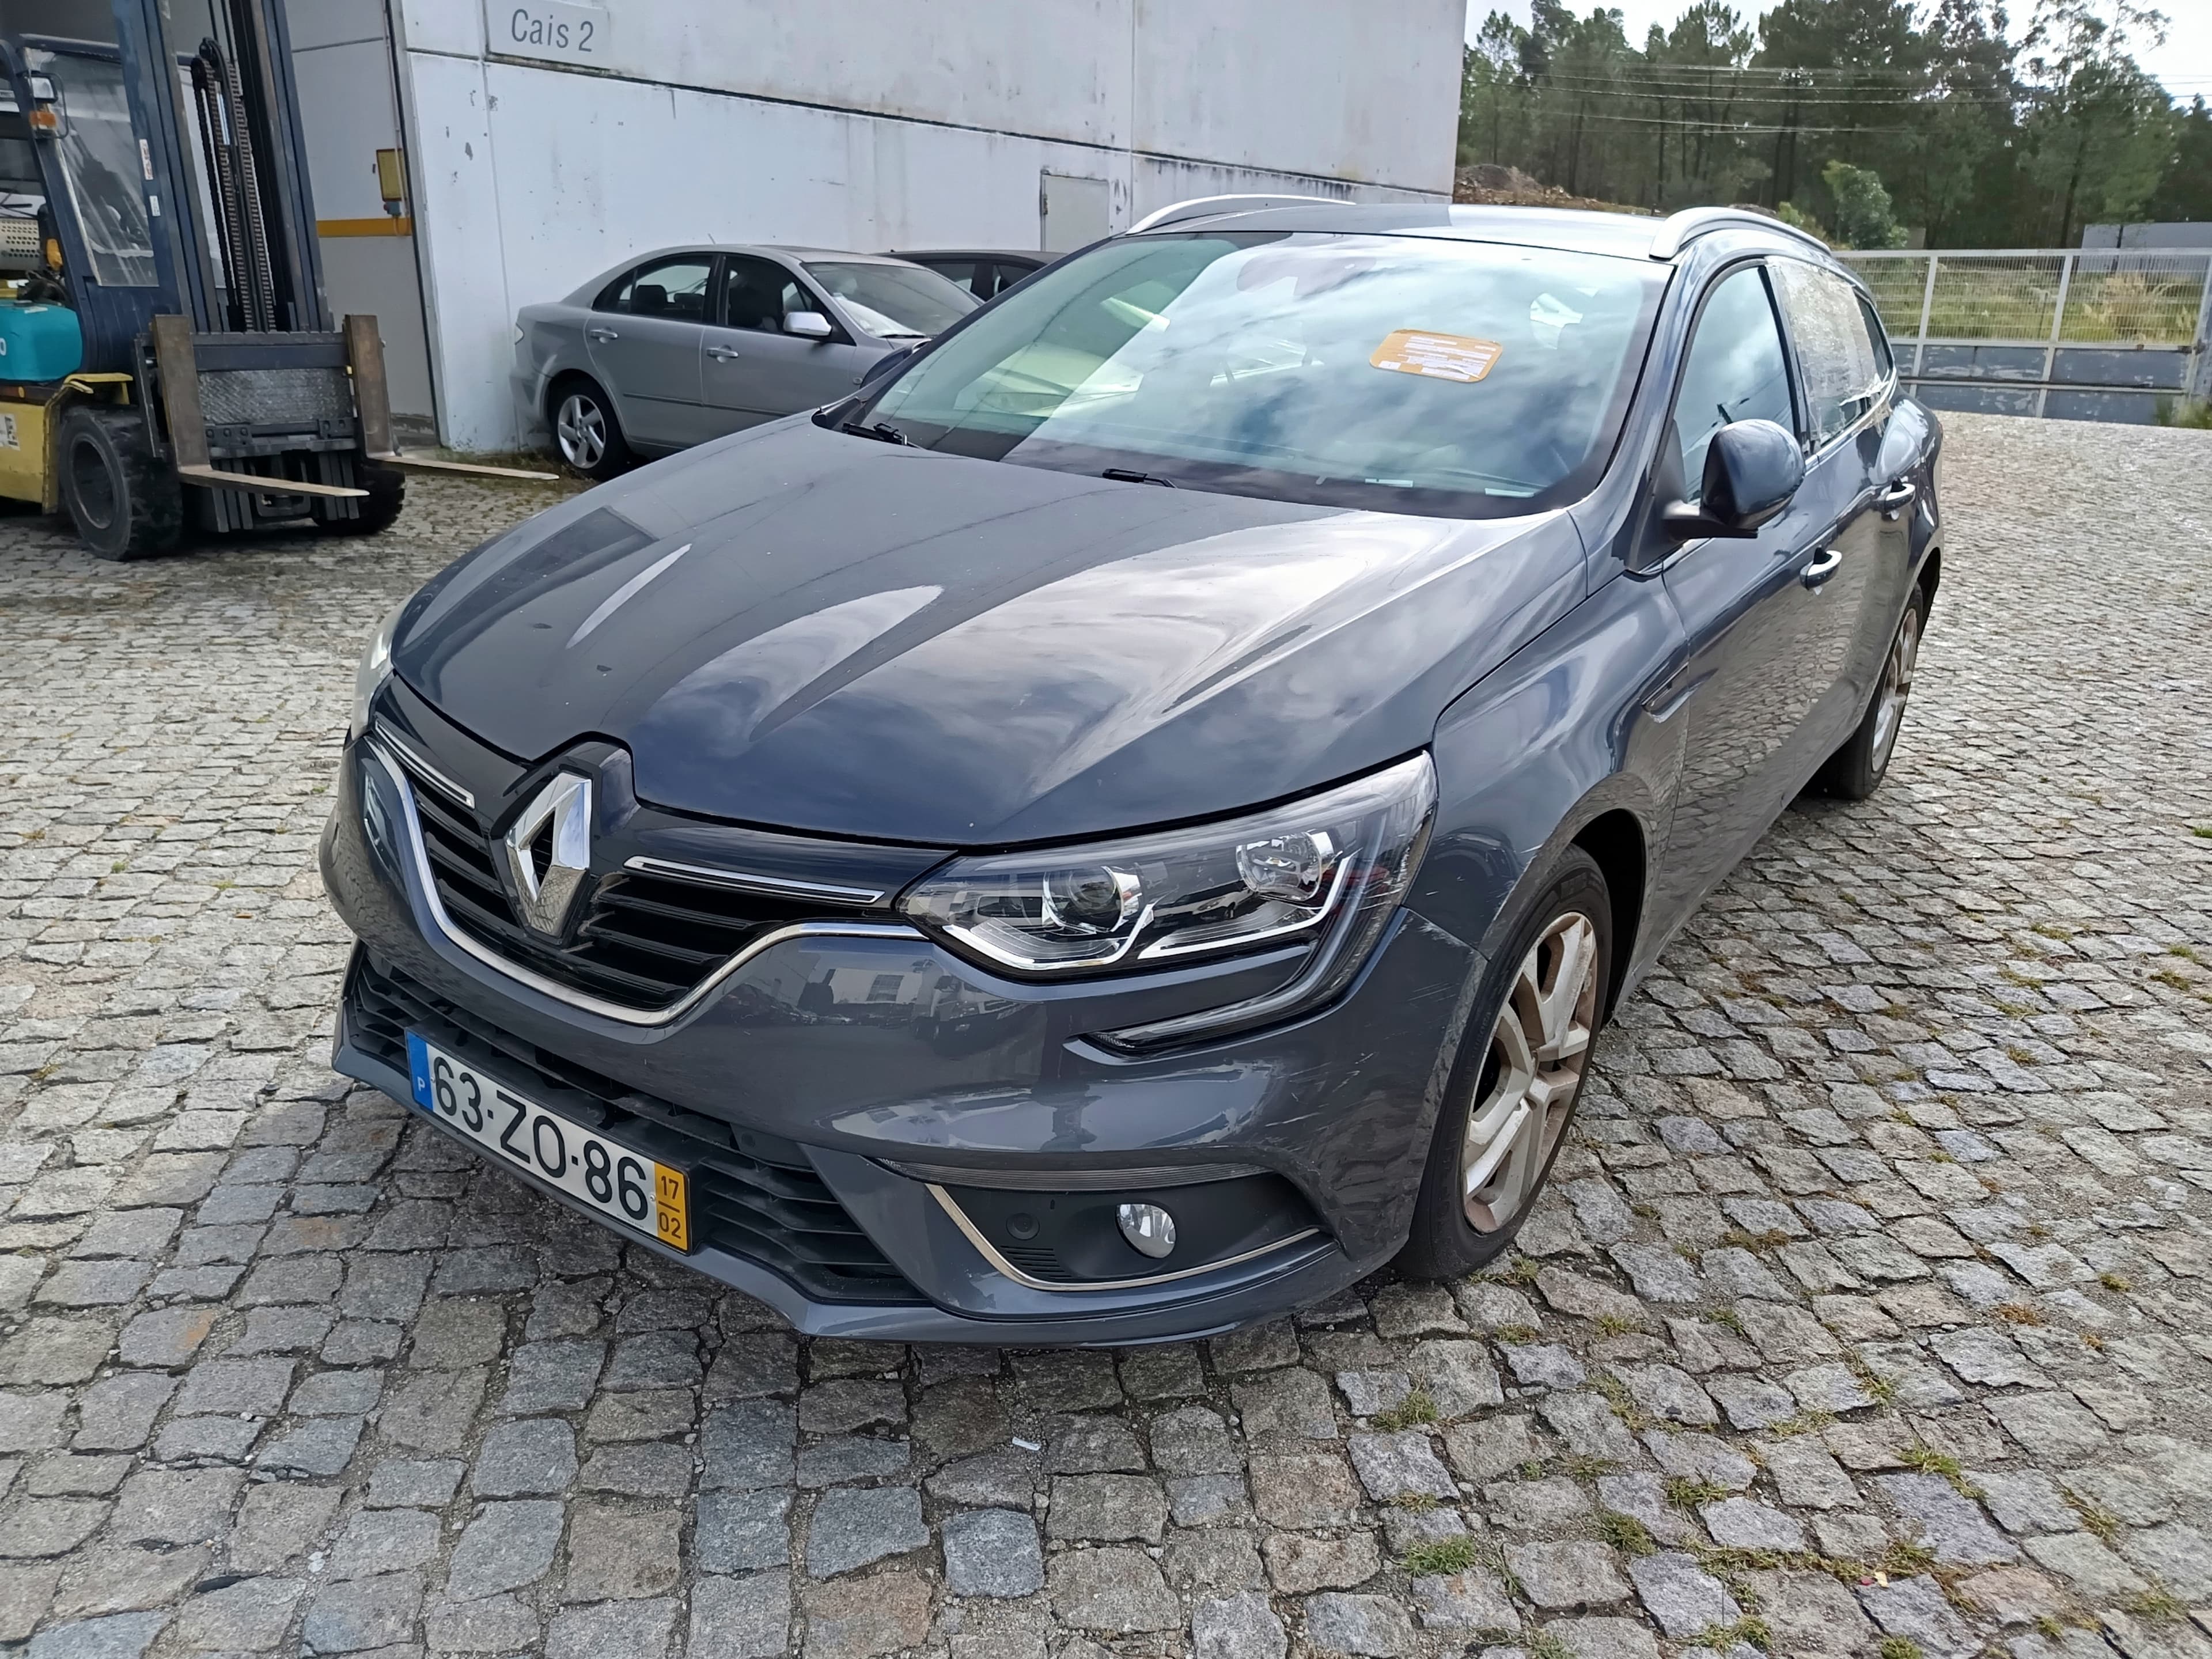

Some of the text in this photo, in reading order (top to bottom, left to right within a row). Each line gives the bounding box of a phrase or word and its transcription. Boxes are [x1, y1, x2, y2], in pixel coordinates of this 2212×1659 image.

[512, 9, 593, 52] Cais 2
[418, 1076, 426, 1092] P
[661, 1175, 679, 1199] 17
[659, 1211, 681, 1239] 02
